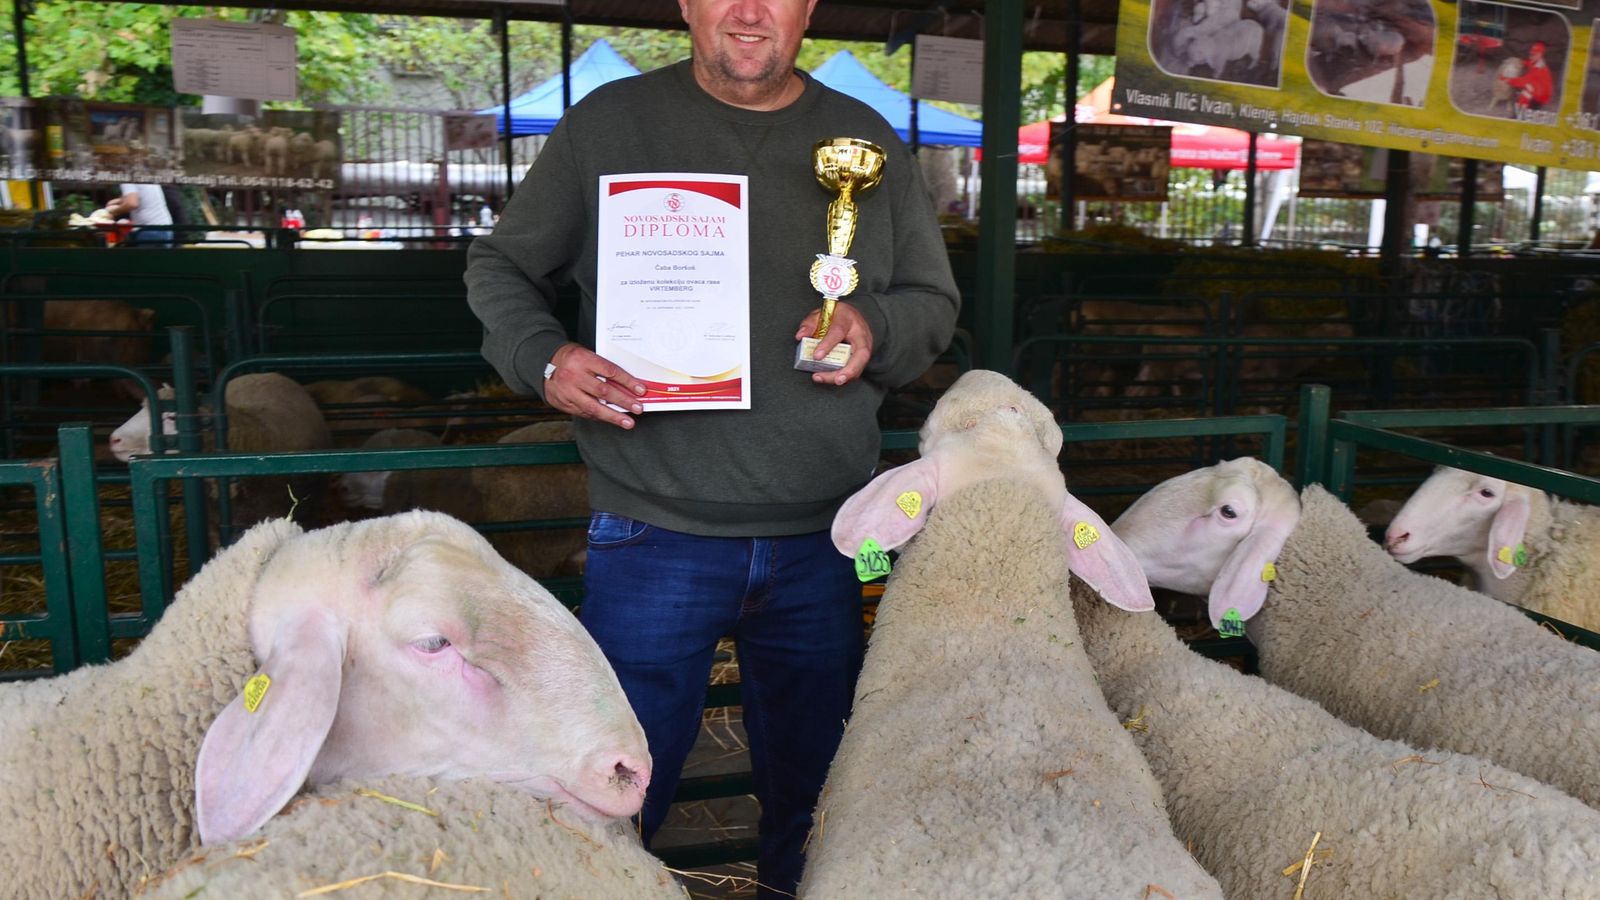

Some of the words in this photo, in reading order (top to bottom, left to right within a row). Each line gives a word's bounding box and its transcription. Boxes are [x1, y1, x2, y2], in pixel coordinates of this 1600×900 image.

[1126, 88, 1171, 108] Vlasnik
[1174, 91, 1199, 111] Ilić
[1200, 95, 1235, 118] Ivan,
[1520, 130, 1553, 154] Ivan
[623, 215, 689, 223] NOVOSADSKI
[690, 215, 726, 224] SAJAM
[624, 223, 726, 238] DIPLOMA
[642, 249, 699, 257] NOVOSADSKOG
